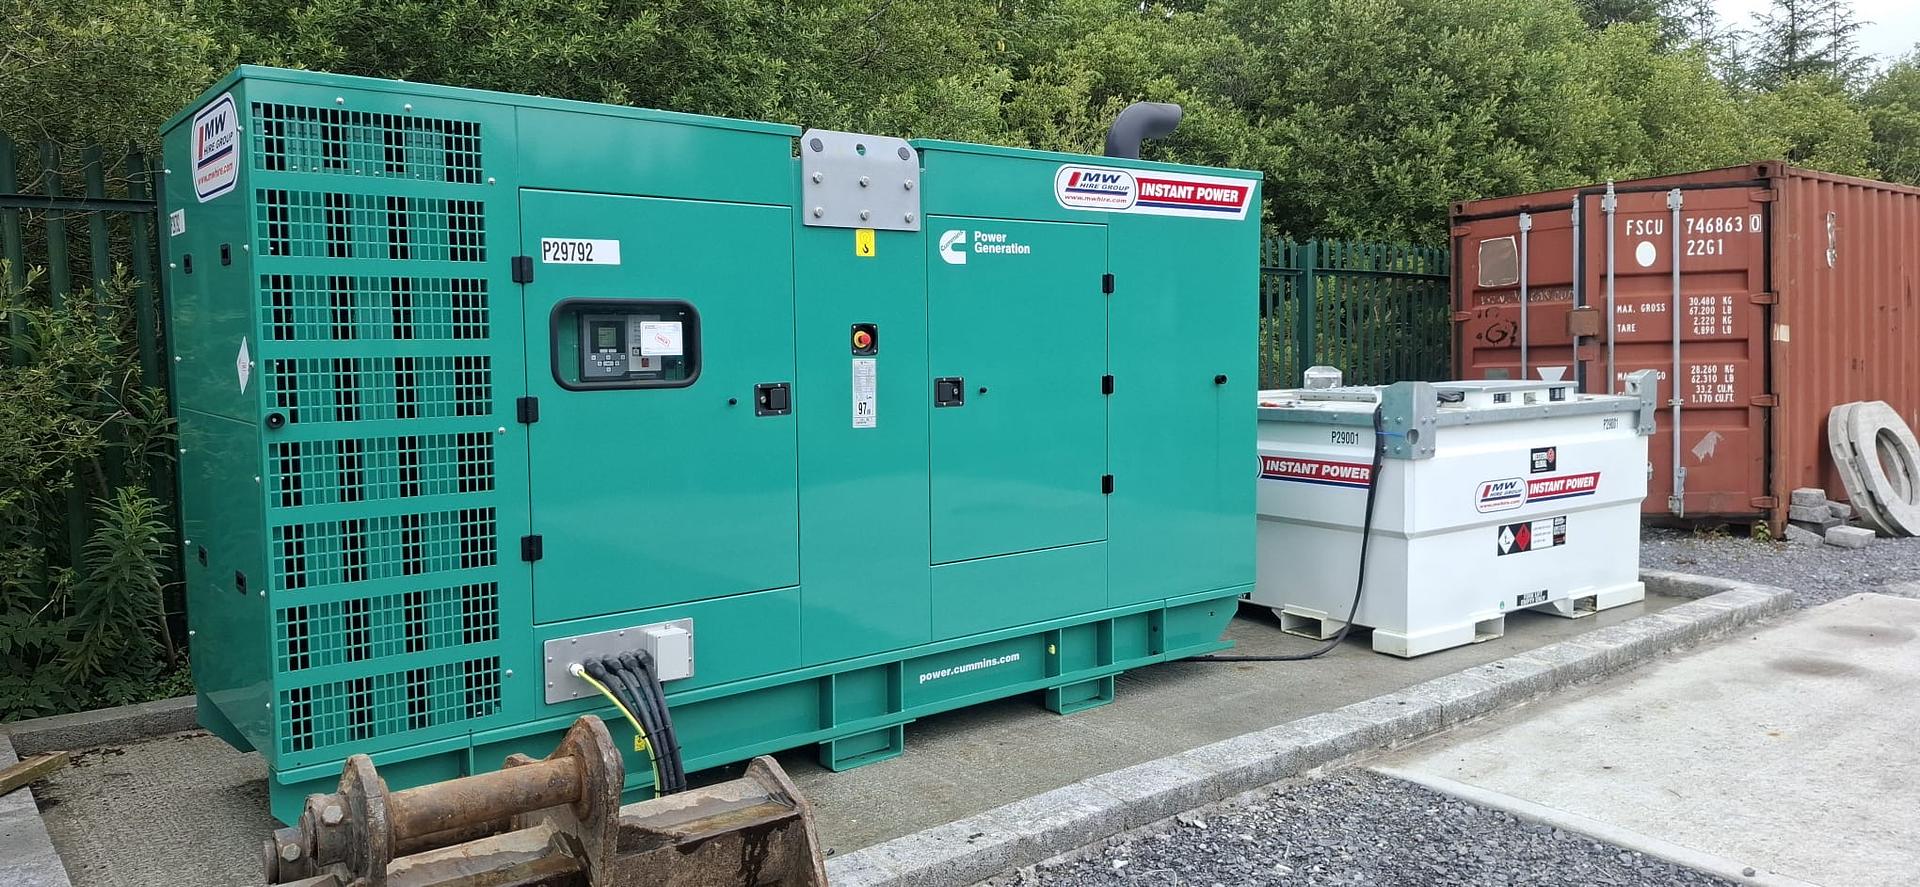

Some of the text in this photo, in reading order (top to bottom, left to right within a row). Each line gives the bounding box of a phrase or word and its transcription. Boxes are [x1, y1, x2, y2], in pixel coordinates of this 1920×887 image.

[204, 111, 227, 141] MW
[203, 131, 234, 155] HIRE GROUP
[1082, 172, 1121, 184] MW
[1141, 182, 1239, 203] INSTANT POWER
[1626, 215, 1760, 236] FSCU 746863 0
[974, 230, 1007, 243] Power
[543, 241, 593, 262] P29792
[974, 242, 1031, 254] Generation
[1686, 238, 1723, 256] 22G1
[1722, 296, 1732, 305] KG
[1617, 303, 1666, 313] MAX. GROSS
[1689, 305, 1732, 315] 67.200 LB
[1693, 316, 1732, 325] 2.220 KG
[1617, 323, 1636, 333] TARE
[1722, 325, 1732, 334] LB
[1724, 364, 1734, 373] KG
[1691, 374, 1734, 384] 62.310 LB
[1696, 384, 1712, 393] 33.2
[1692, 394, 1712, 403] 1.170
[858, 402, 867, 415] 97
[1331, 430, 1359, 445] P29001
[1266, 460, 1370, 480] INSTANT POWER
[1492, 481, 1517, 491] MW
[1530, 476, 1594, 495] INSTANT POWER
[919, 653, 1020, 684] power.cummins.com
